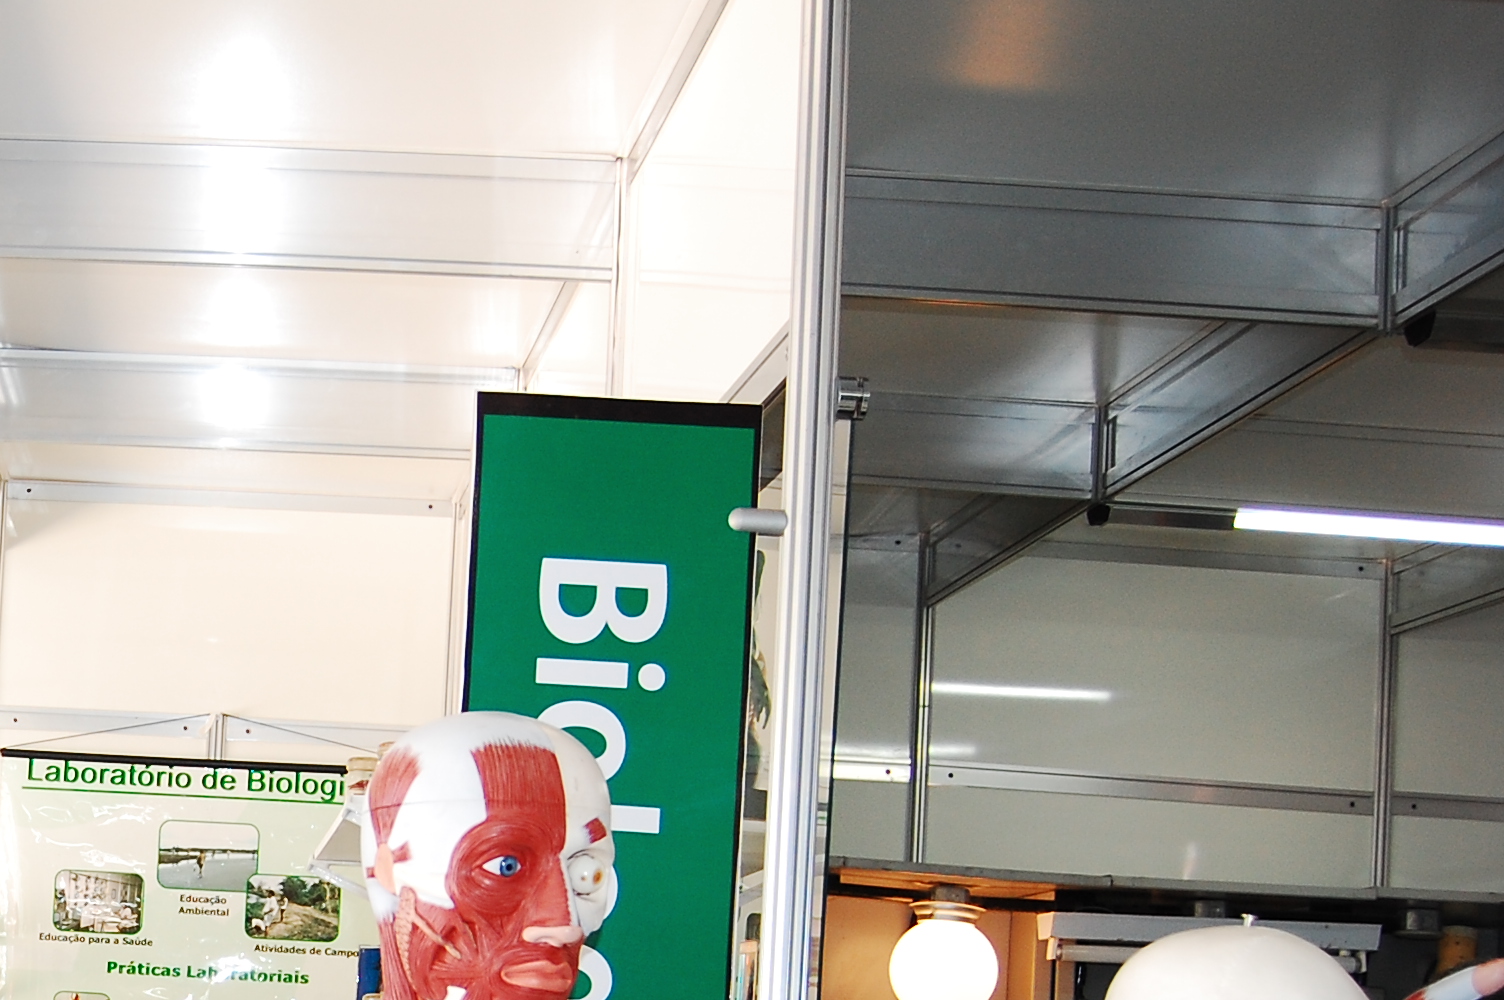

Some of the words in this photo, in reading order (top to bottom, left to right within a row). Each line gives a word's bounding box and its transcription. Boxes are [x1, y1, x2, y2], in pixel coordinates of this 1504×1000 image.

[201, 768, 237, 791] de
[247, 769, 345, 801] Biologi
[179, 894, 227, 906] Educação
[178, 906, 230, 917] Ambiental
[39, 932, 86, 945] Educação
[88, 936, 111, 946] para
[254, 944, 307, 955] Atividades
[309, 946, 322, 956] de
[324, 948, 360, 958] Campo
[106, 960, 181, 977] Práticas
